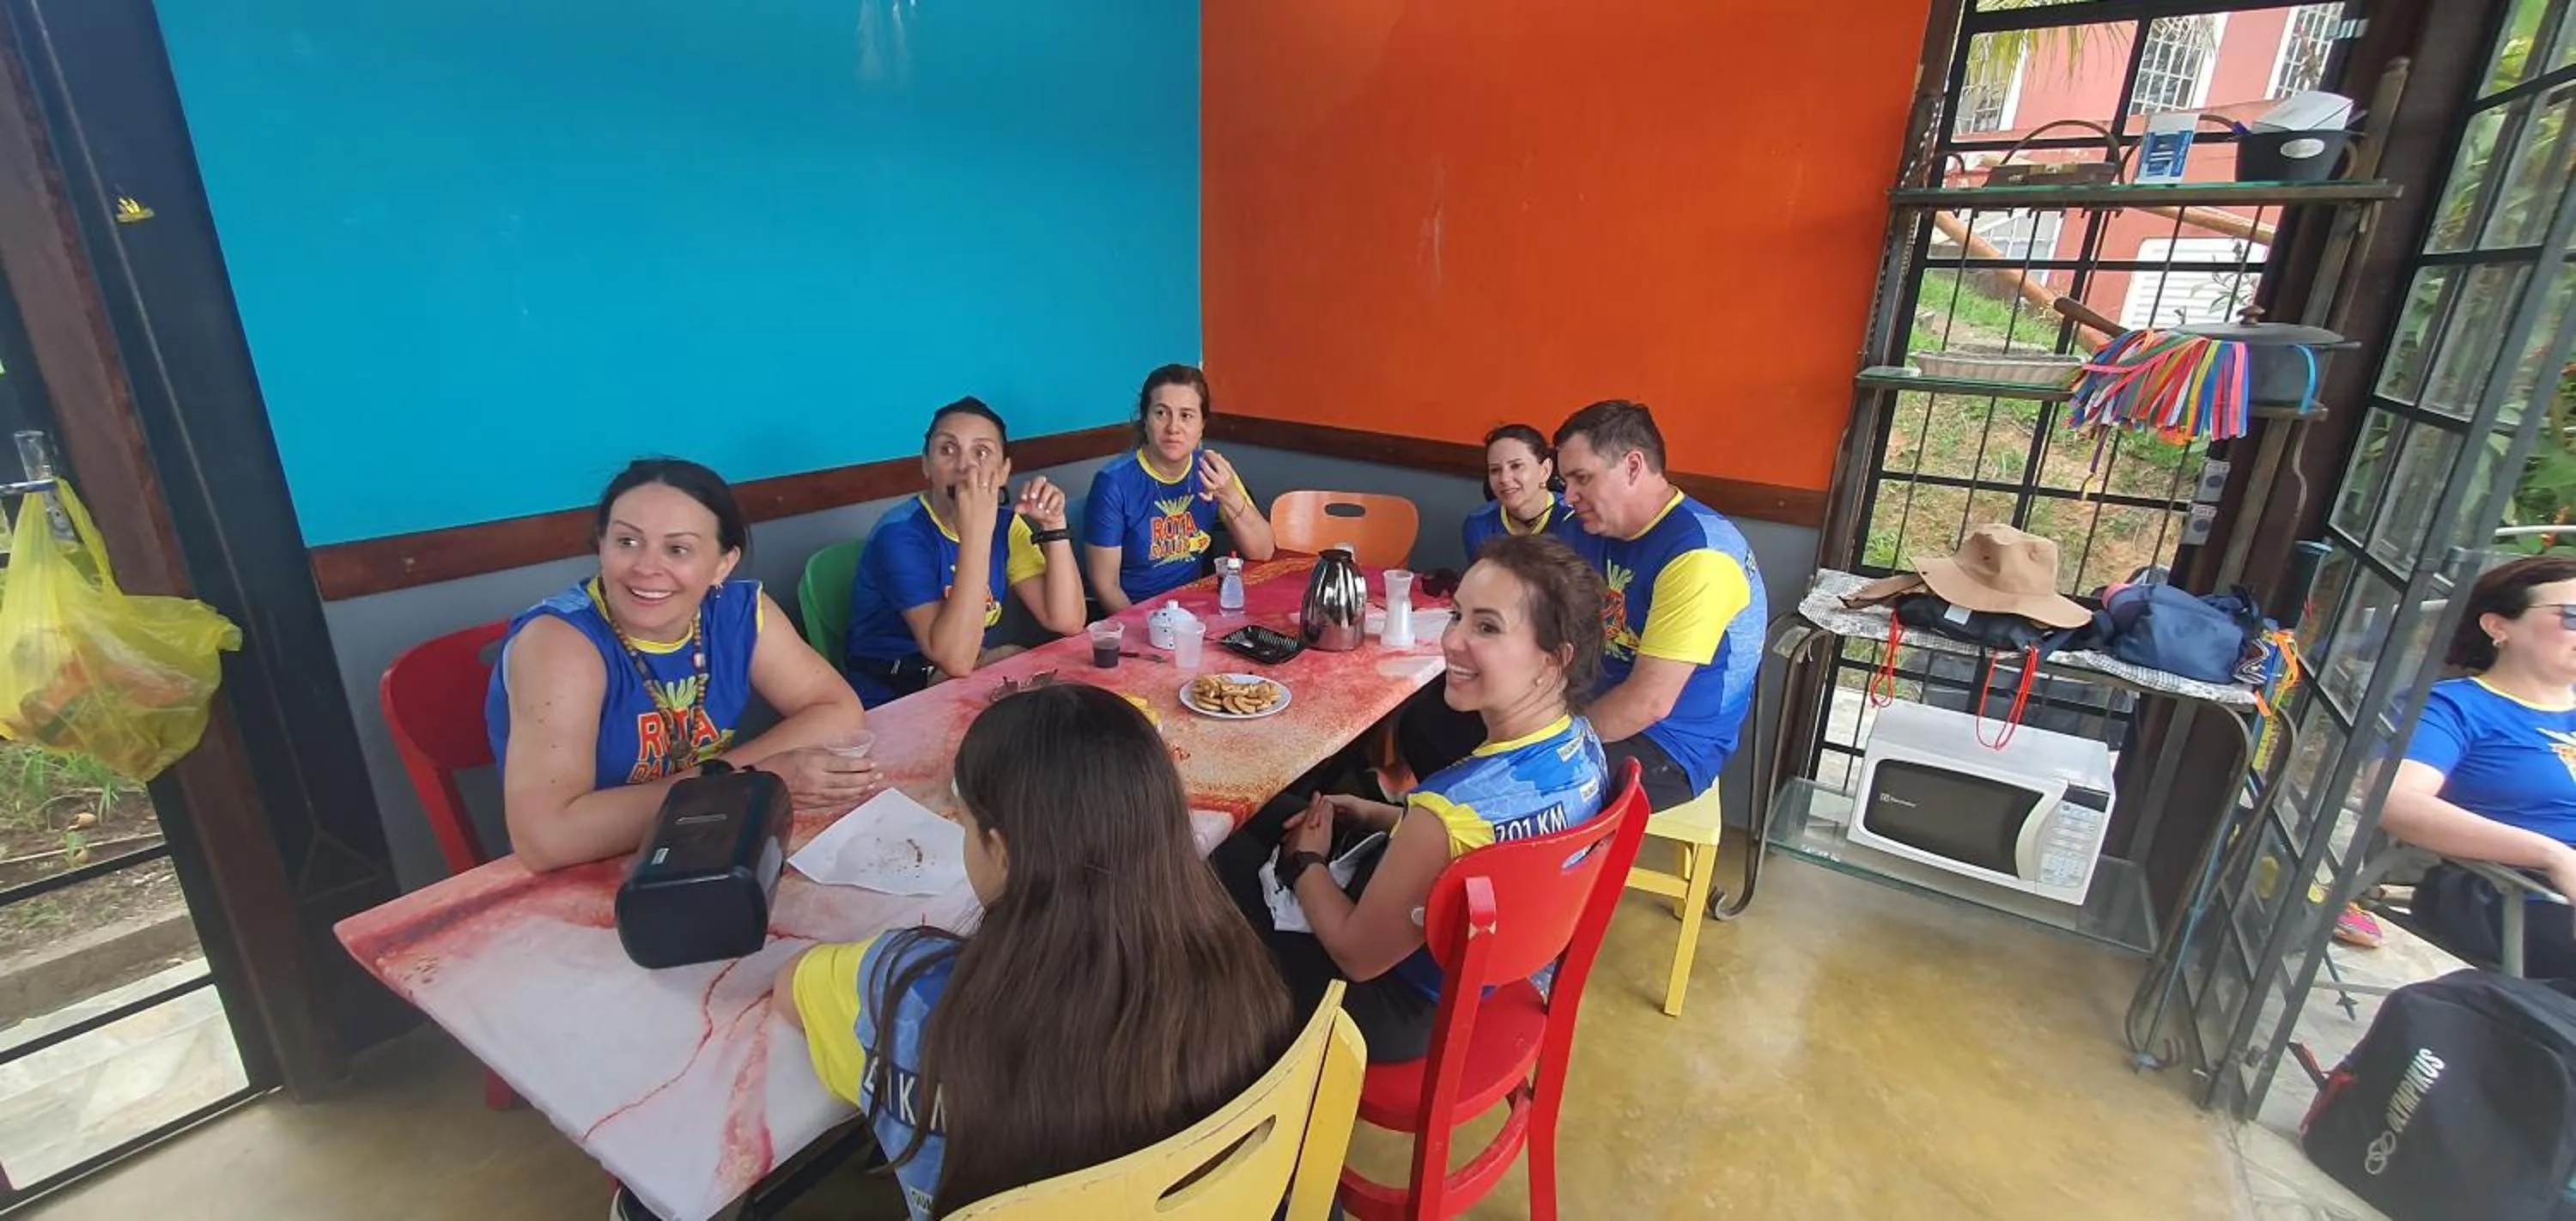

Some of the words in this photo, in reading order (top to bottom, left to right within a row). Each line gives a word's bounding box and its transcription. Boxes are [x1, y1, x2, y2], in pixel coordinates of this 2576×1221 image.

[1151, 511, 1197, 543] ROTA
[1537, 804, 1568, 836] KM
[2387, 1048, 2445, 1133] OLYMPIKUS
